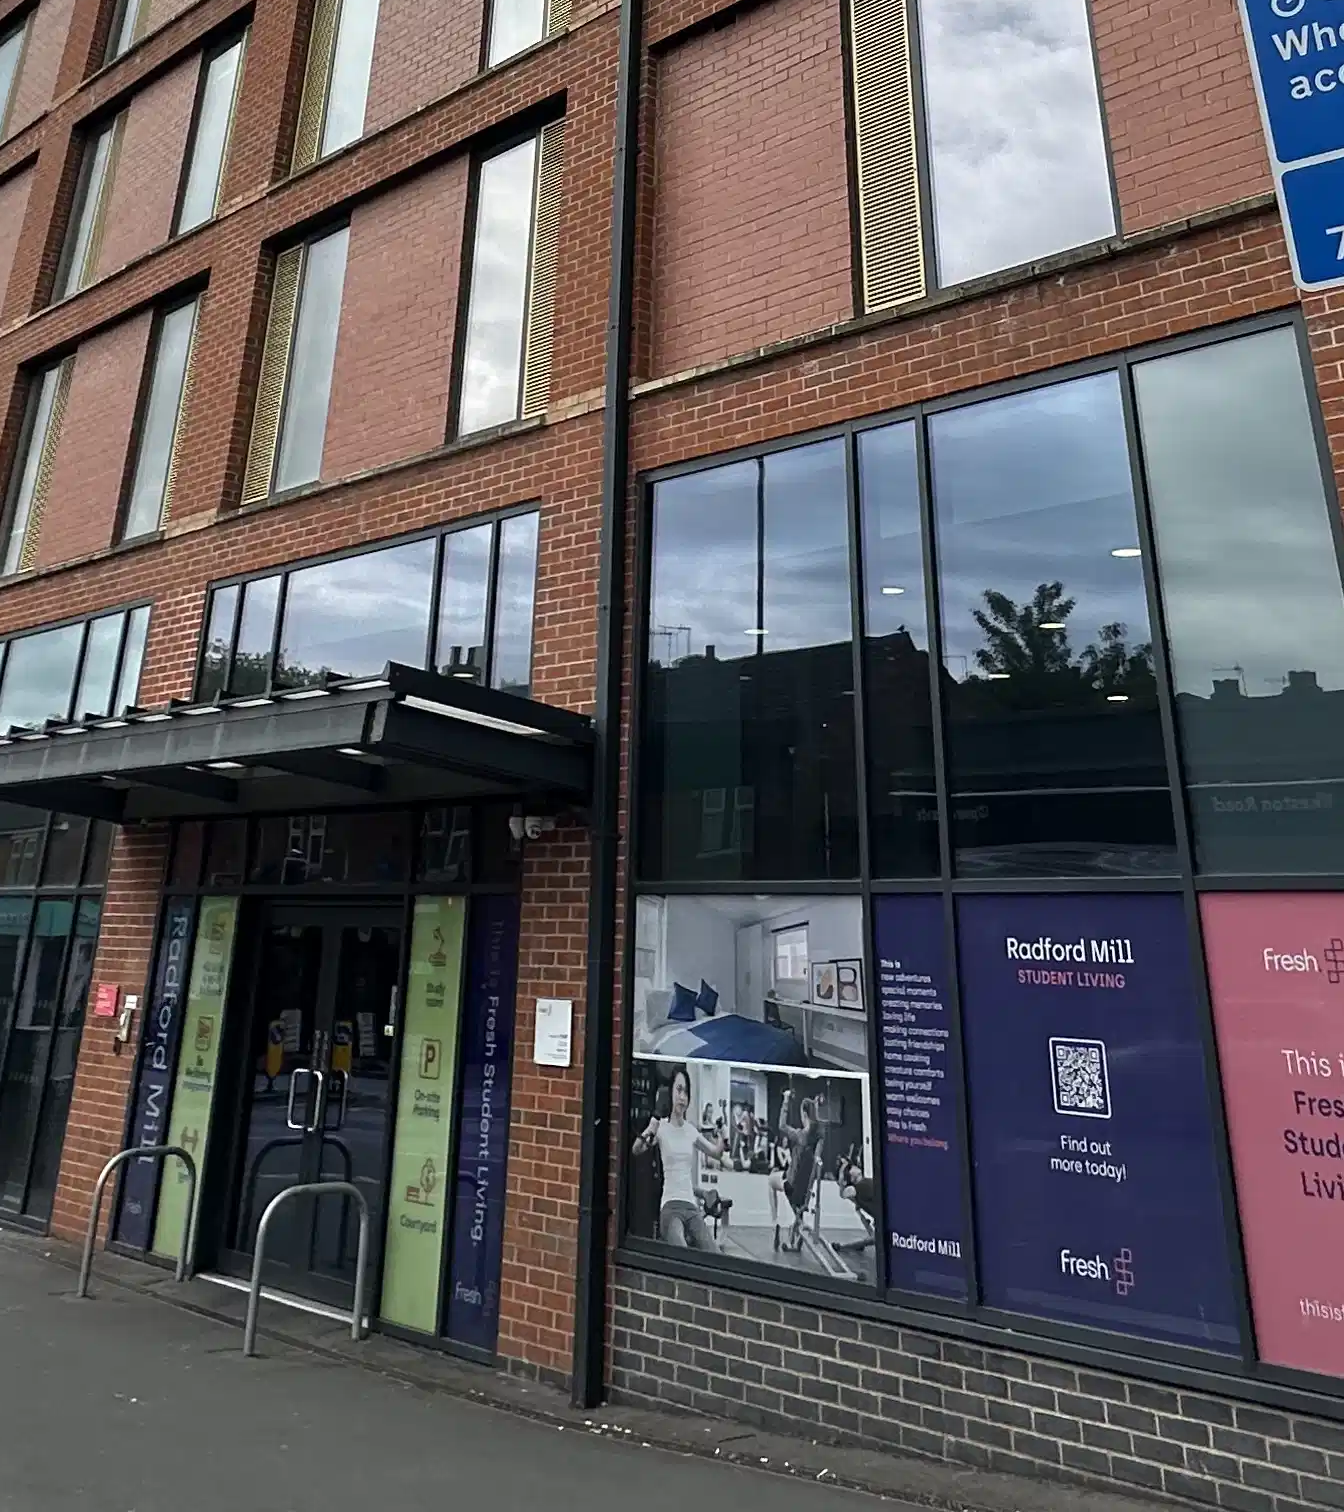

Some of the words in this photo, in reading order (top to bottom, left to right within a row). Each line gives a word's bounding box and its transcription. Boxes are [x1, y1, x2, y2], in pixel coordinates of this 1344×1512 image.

[1006, 936, 1086, 963] Radford
[1089, 938, 1135, 964] Mill
[152, 916, 188, 1070] Radford
[1017, 969, 1074, 986] STUDENT
[1076, 972, 1126, 989] LIVING
[1280, 1048, 1332, 1078] This
[479, 1063, 496, 1161] Student
[1060, 1134, 1088, 1153] Find
[1089, 1141, 1112, 1156] out
[1050, 1157, 1083, 1173] more
[1084, 1159, 1128, 1183] today!
[892, 1231, 936, 1254] Radford
[937, 1239, 962, 1259] Mill
